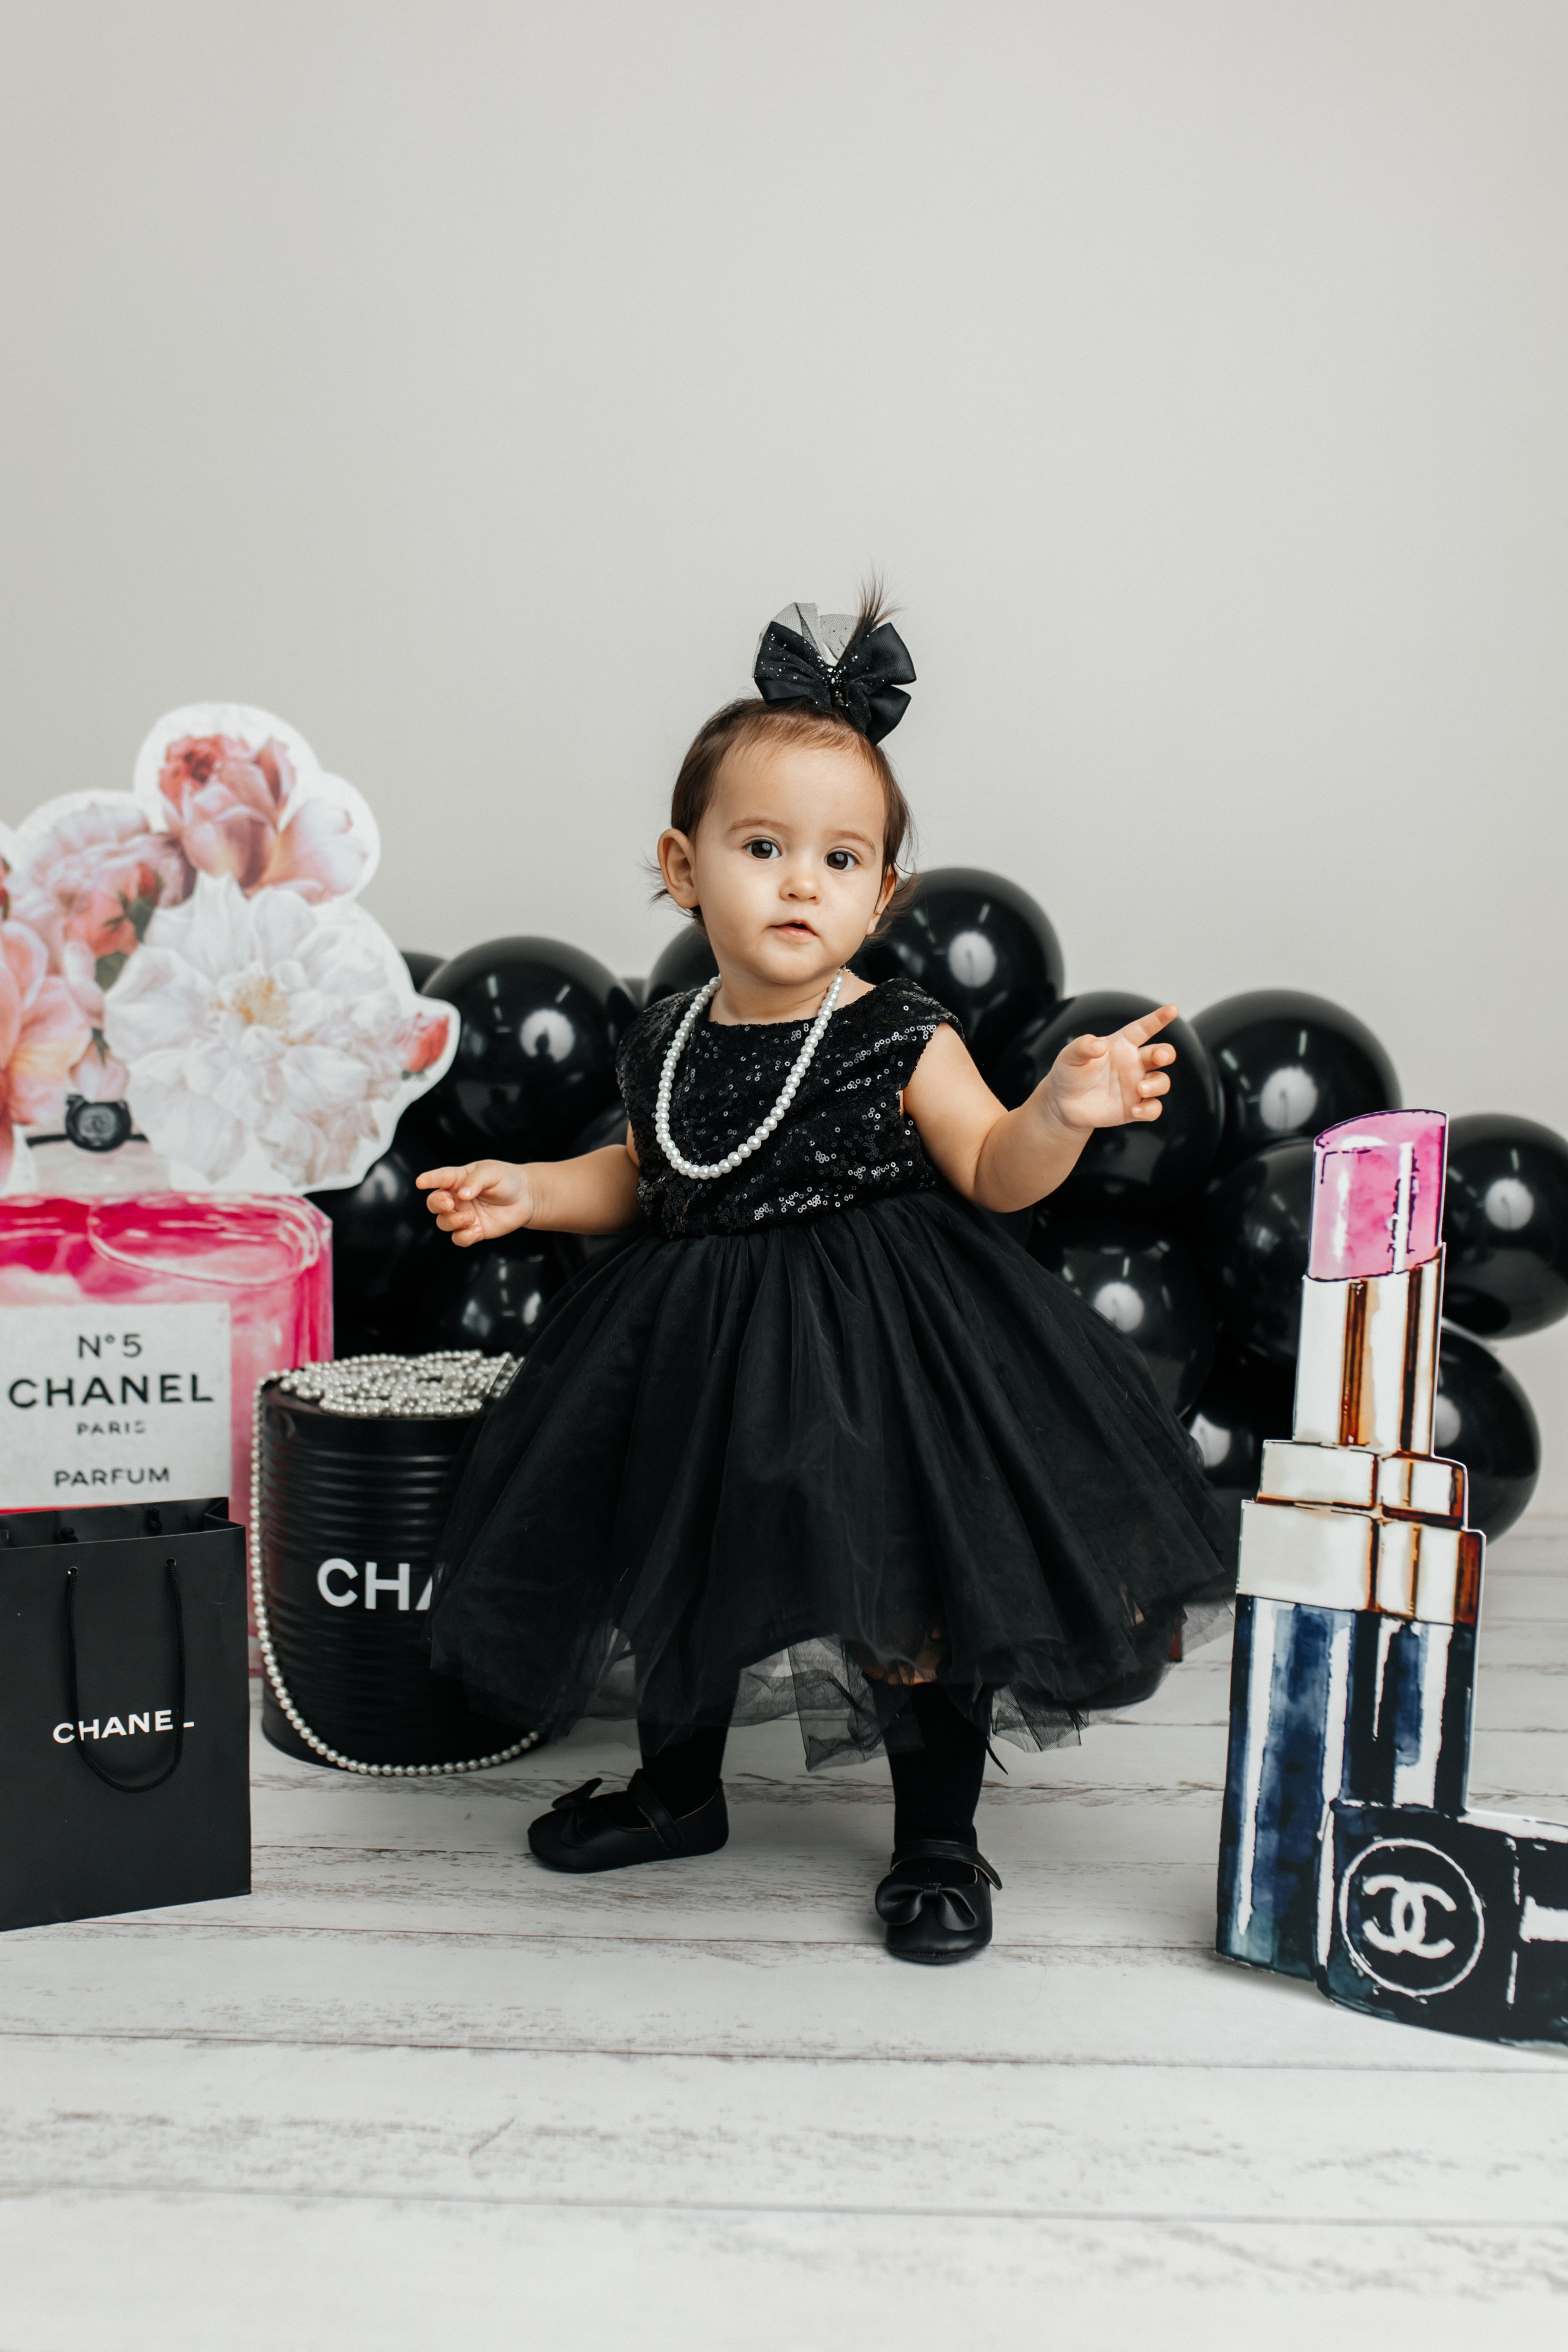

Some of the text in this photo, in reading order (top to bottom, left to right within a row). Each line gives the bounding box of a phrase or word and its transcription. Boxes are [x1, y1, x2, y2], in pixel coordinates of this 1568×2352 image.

[9, 1373, 213, 1409] CHANEL
[77, 1420, 146, 1436] PARIS
[54, 1468, 170, 1487] PARFUM
